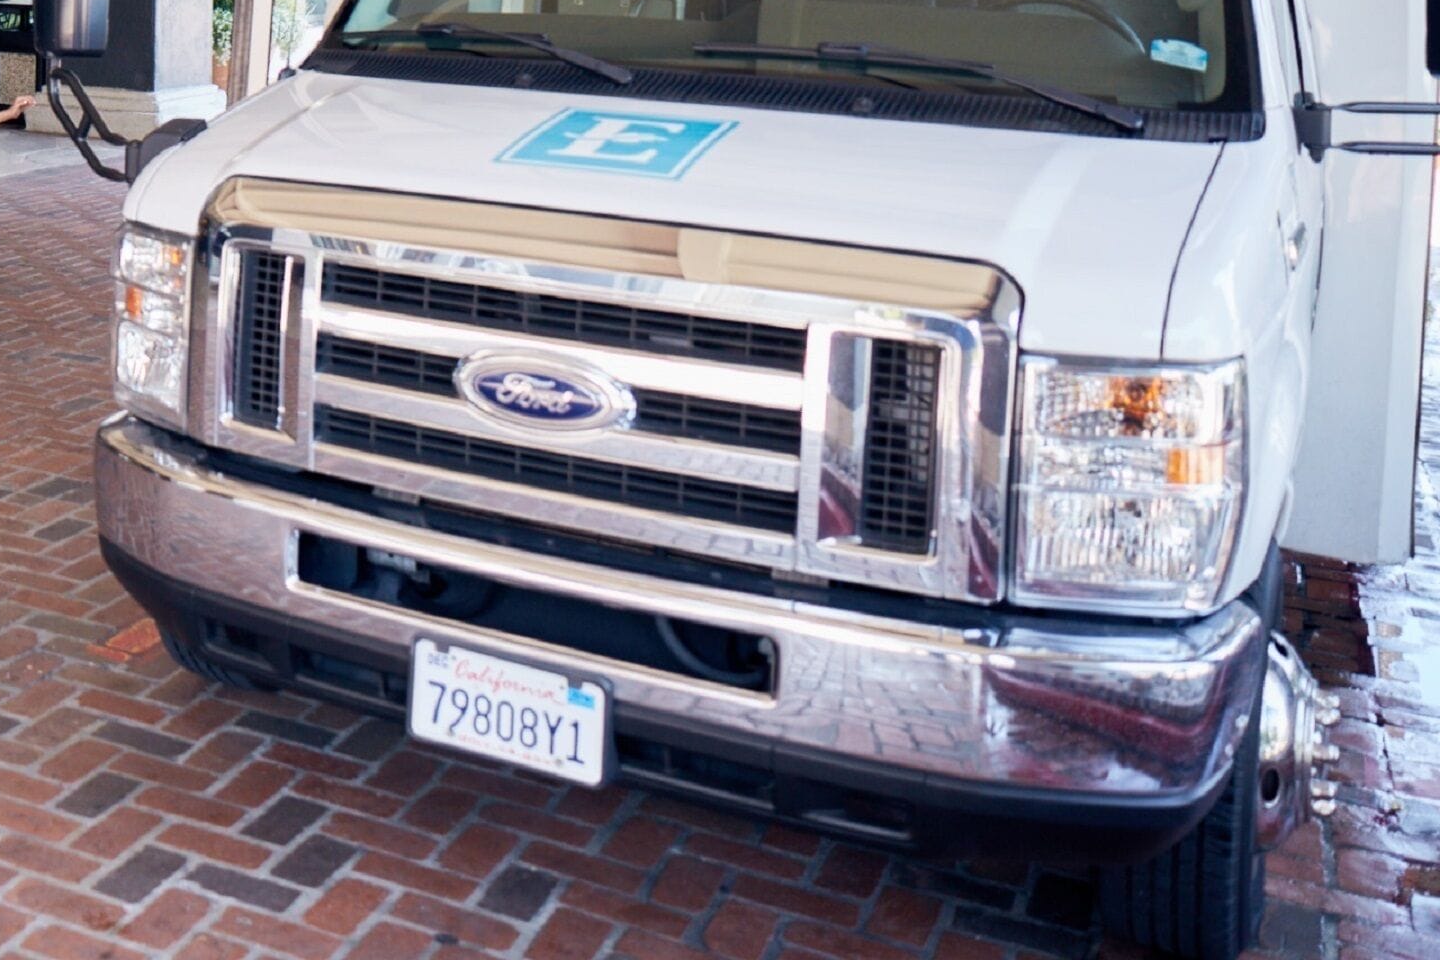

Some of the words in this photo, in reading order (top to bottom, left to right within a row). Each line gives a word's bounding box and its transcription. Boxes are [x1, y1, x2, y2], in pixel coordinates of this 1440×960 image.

[546, 116, 686, 165] E
[494, 372, 575, 414] Ford
[454, 657, 563, 704] California
[428, 680, 585, 765] 79808Y1
